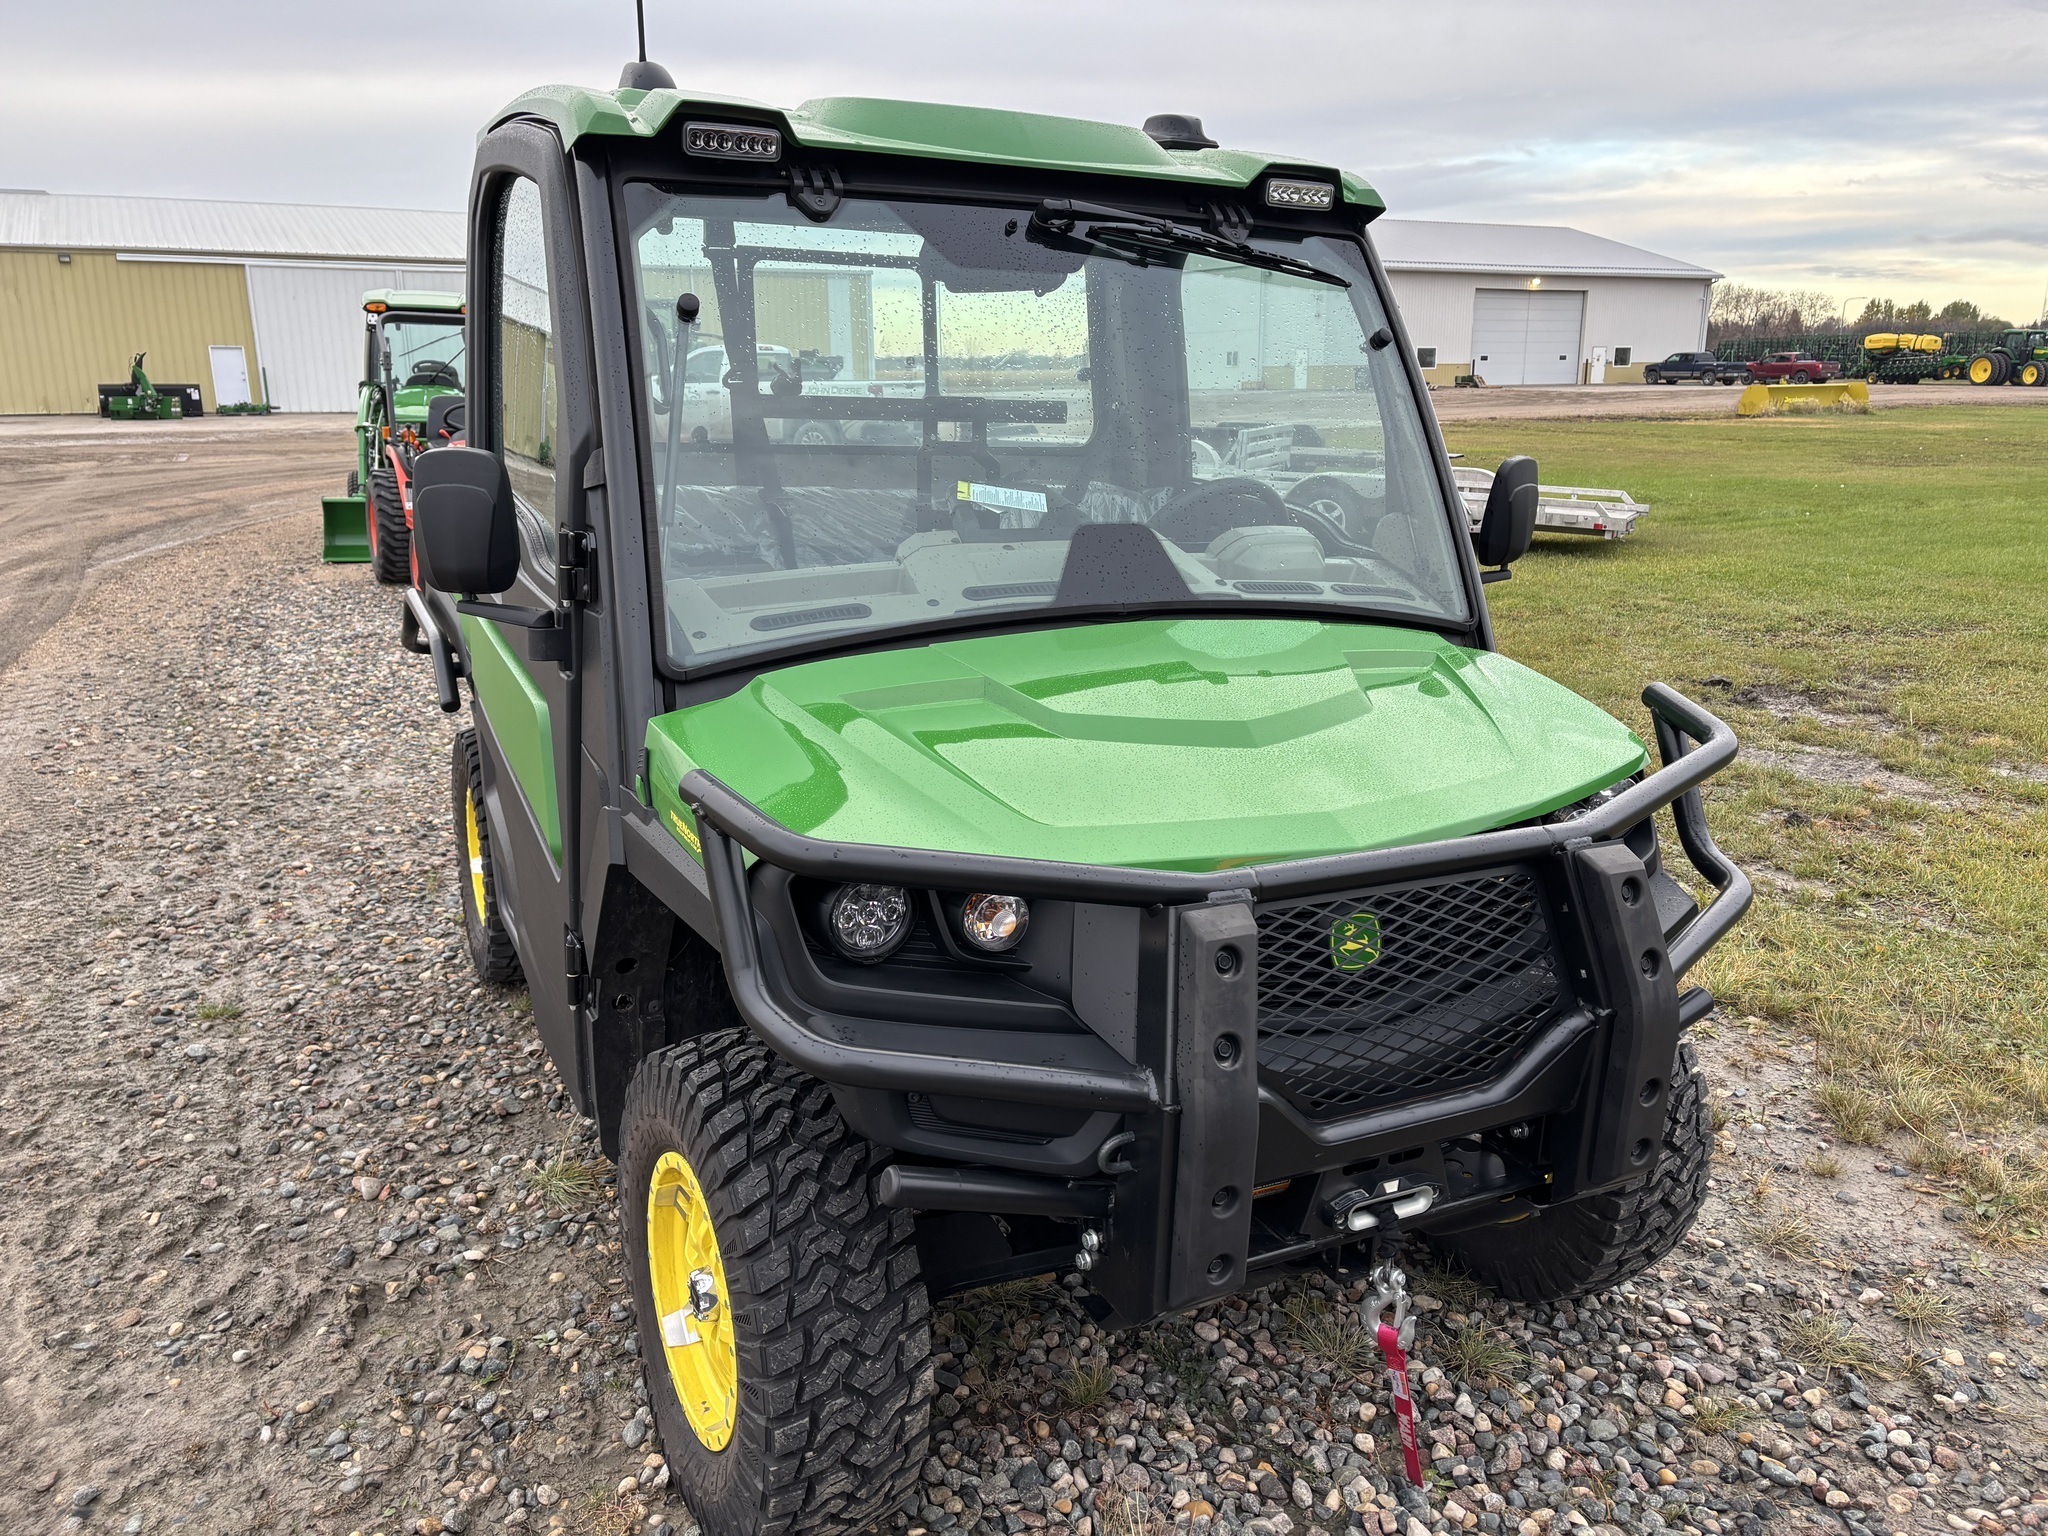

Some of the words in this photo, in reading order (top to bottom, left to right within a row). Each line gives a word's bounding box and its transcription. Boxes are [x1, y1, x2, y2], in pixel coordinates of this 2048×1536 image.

[805, 386, 830, 395] JOHN
[831, 386, 862, 395] DEERE
[1398, 1412, 1414, 1451] WARN
